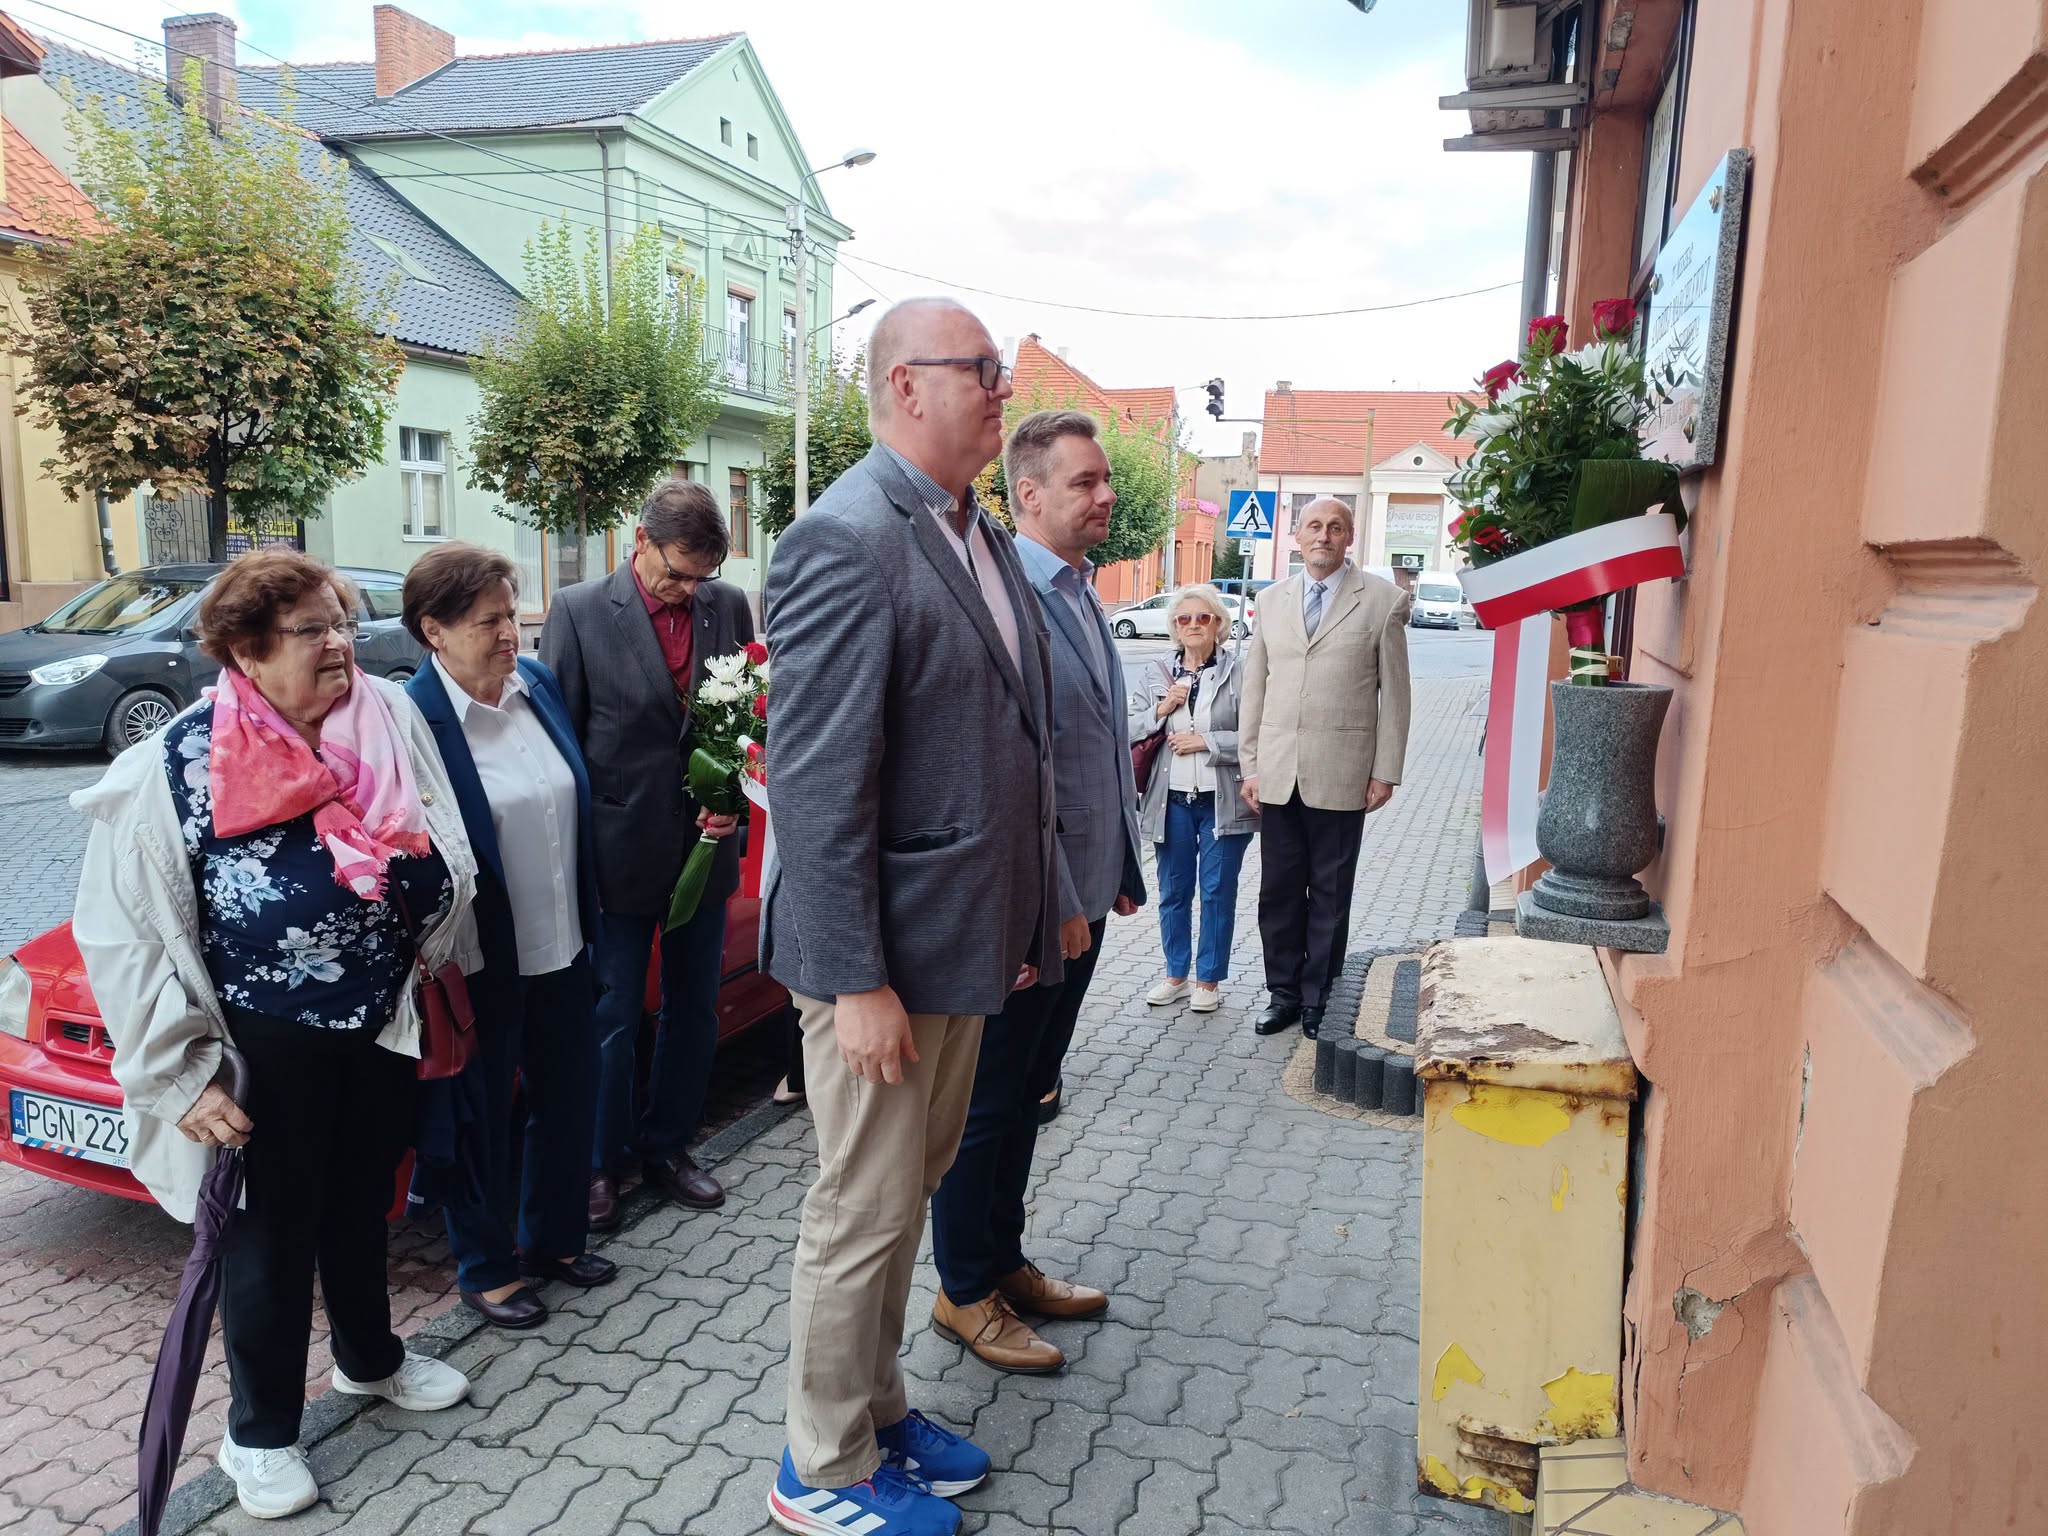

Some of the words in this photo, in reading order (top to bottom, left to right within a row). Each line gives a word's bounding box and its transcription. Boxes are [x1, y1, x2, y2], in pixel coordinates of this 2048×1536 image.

[1395, 512, 1414, 521] NEW
[1415, 513, 1439, 521] BODY
[15, 1118, 25, 1130] PL
[26, 1100, 75, 1143] PGN
